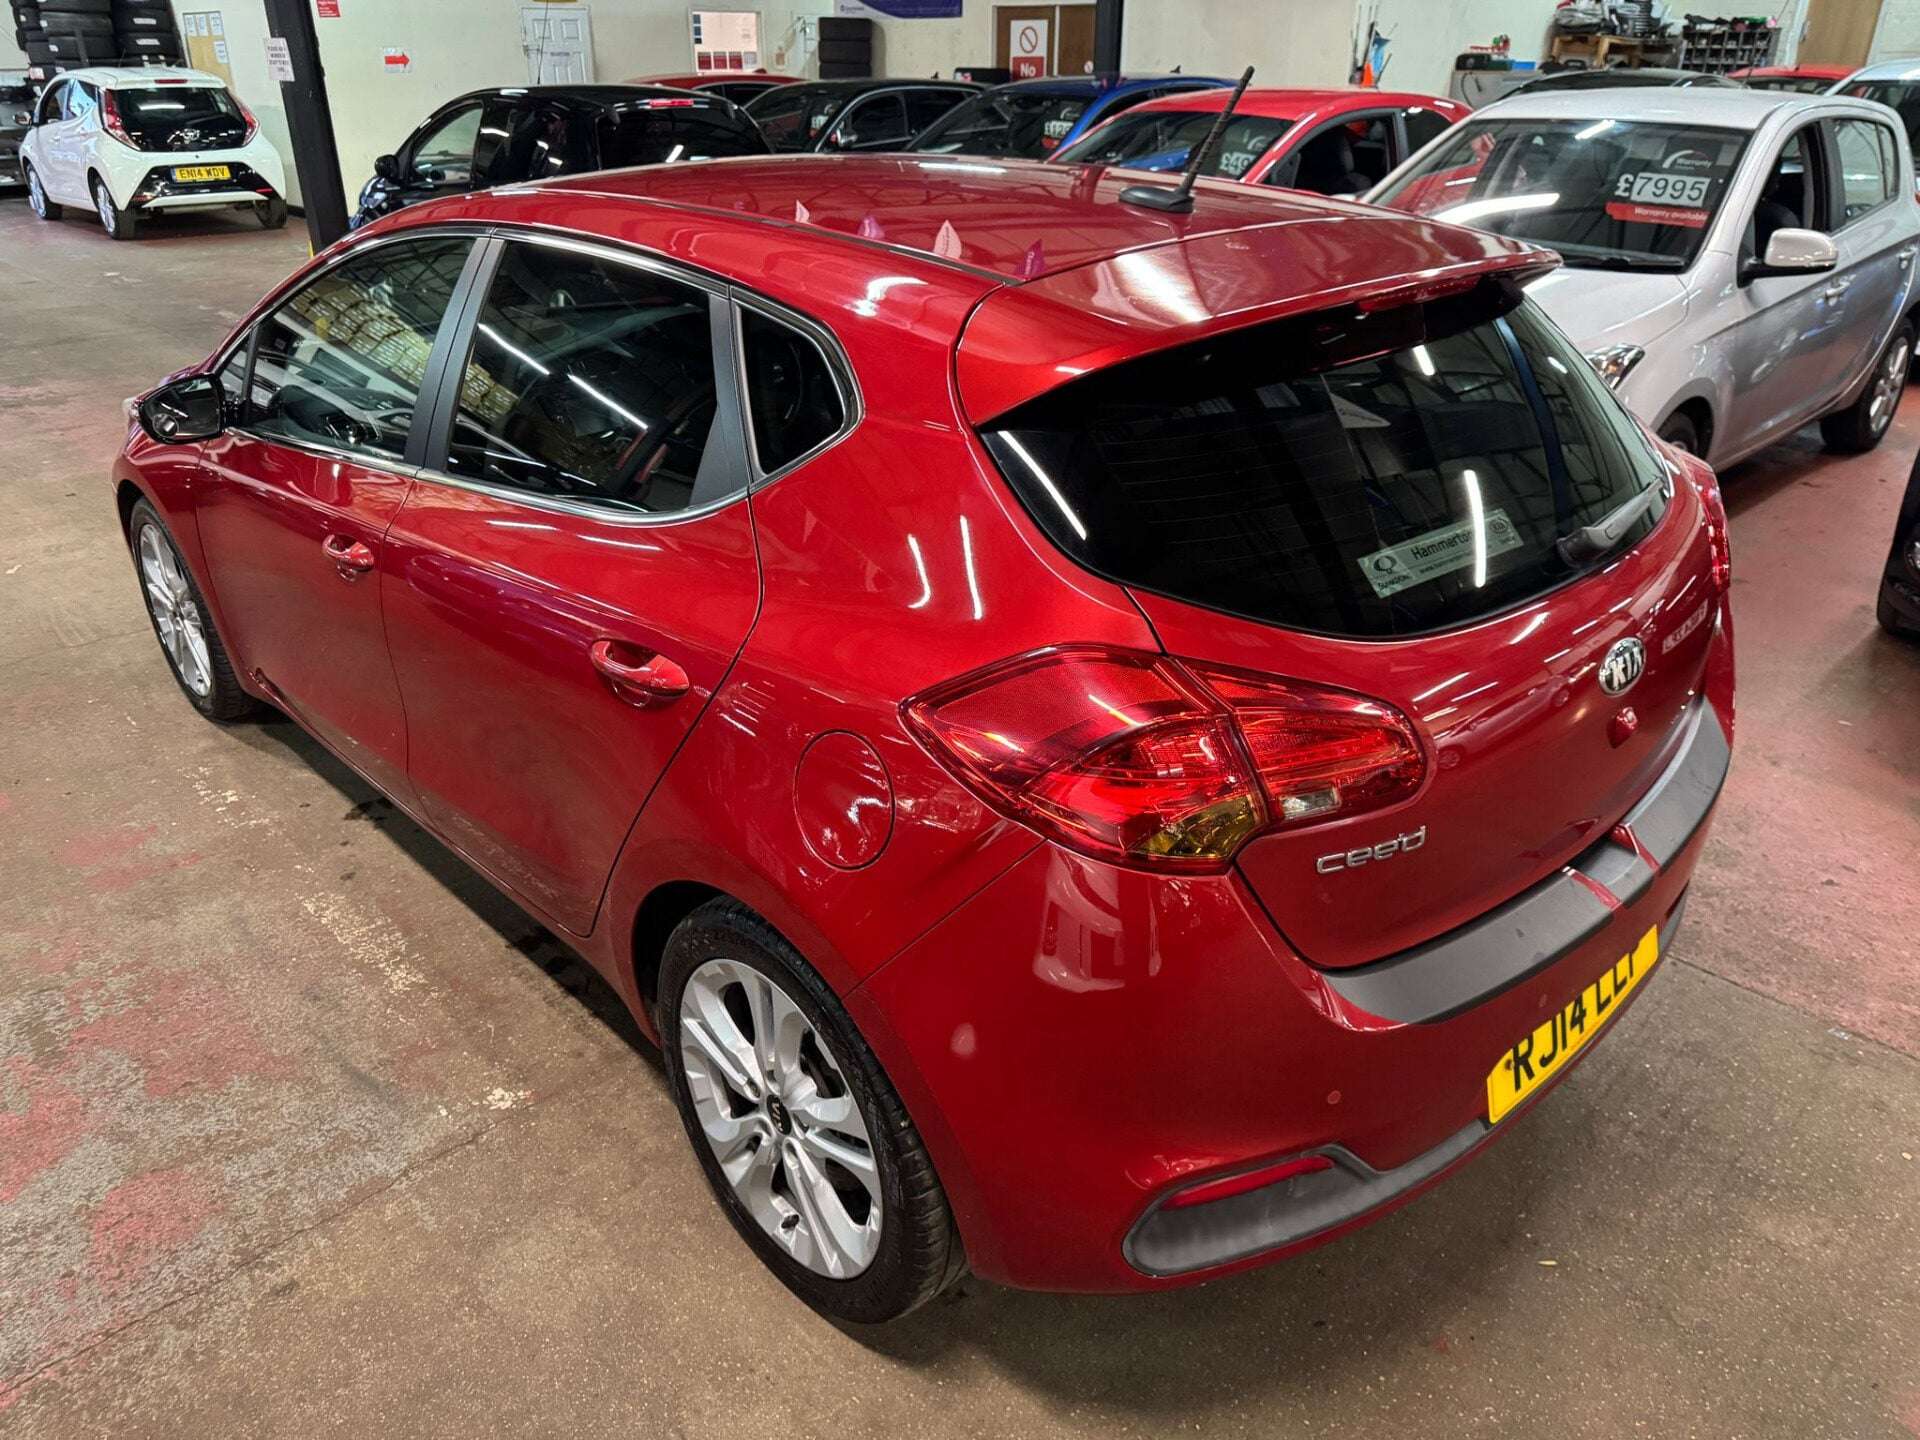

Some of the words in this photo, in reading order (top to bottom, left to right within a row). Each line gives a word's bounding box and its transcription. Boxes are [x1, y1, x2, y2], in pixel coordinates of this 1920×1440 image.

[1020, 62, 1037, 78] No
[1614, 173, 1706, 202] £7995
[1607, 644, 1643, 692] KIA
[1316, 825, 1426, 874] cee'd
[1512, 995, 1587, 1092] RJ14
